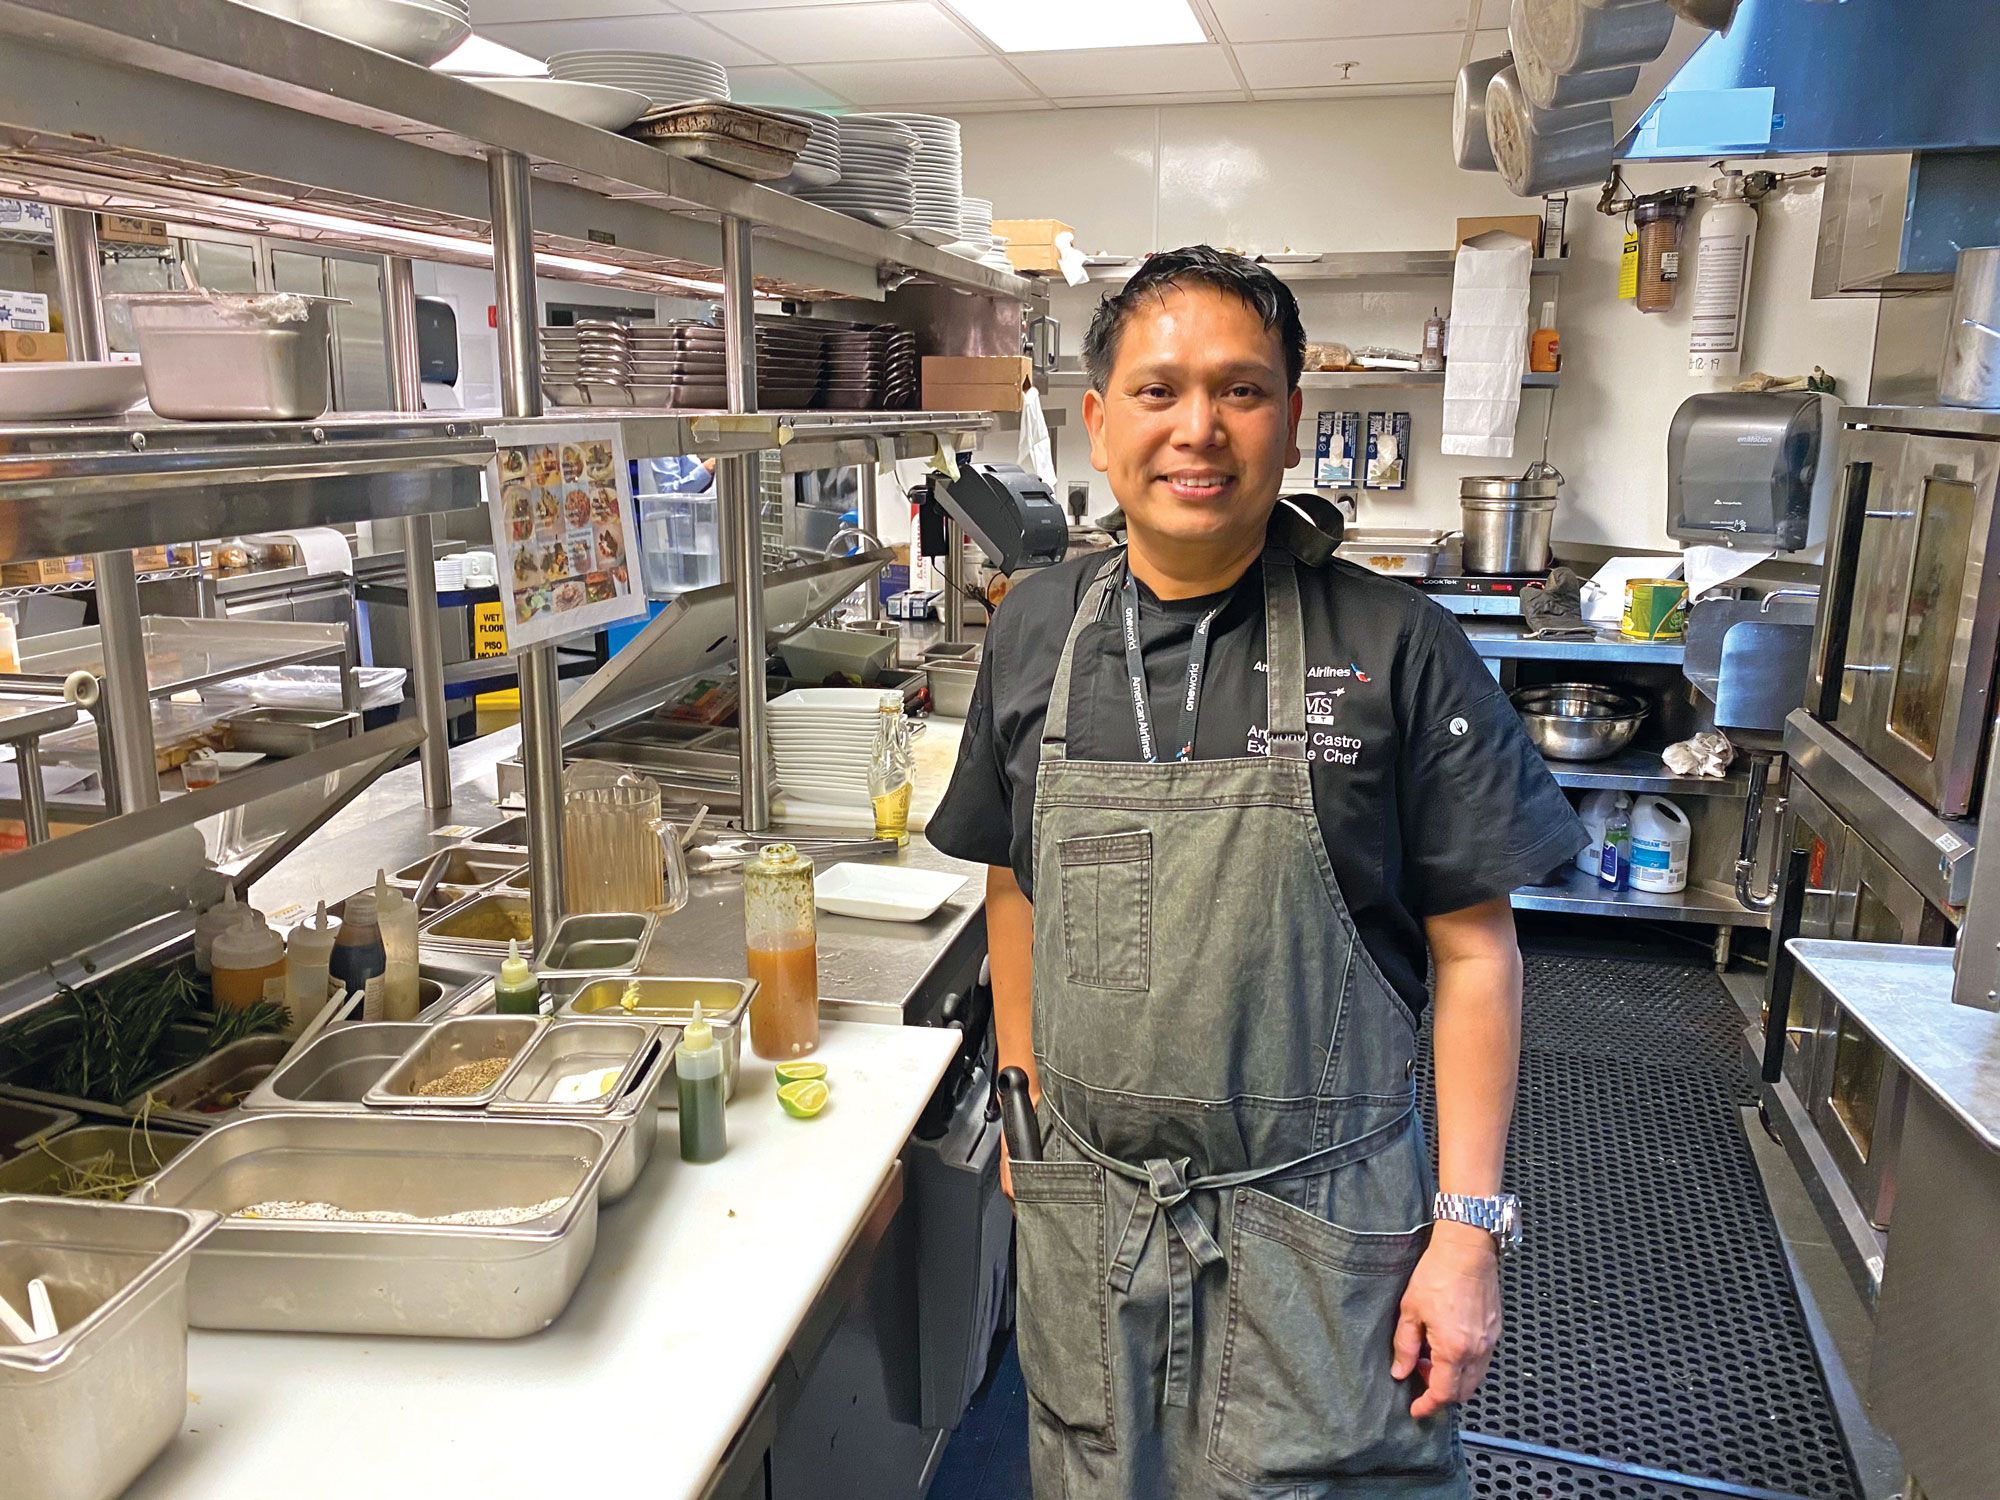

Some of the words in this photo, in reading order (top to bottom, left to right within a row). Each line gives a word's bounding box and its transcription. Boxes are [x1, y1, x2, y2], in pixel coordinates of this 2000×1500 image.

[483, 613, 501, 622] WET
[480, 624, 505, 633] FLOOR
[1125, 607, 1138, 650] oneworld
[484, 641, 503, 650] PISO
[1307, 666, 1351, 678] Airlines
[1185, 663, 1200, 712] oneworld
[1132, 676, 1146, 721] American
[1137, 721, 1152, 760] Airlines
[1312, 732, 1362, 750] Castro
[1323, 748, 1359, 766] Chef
